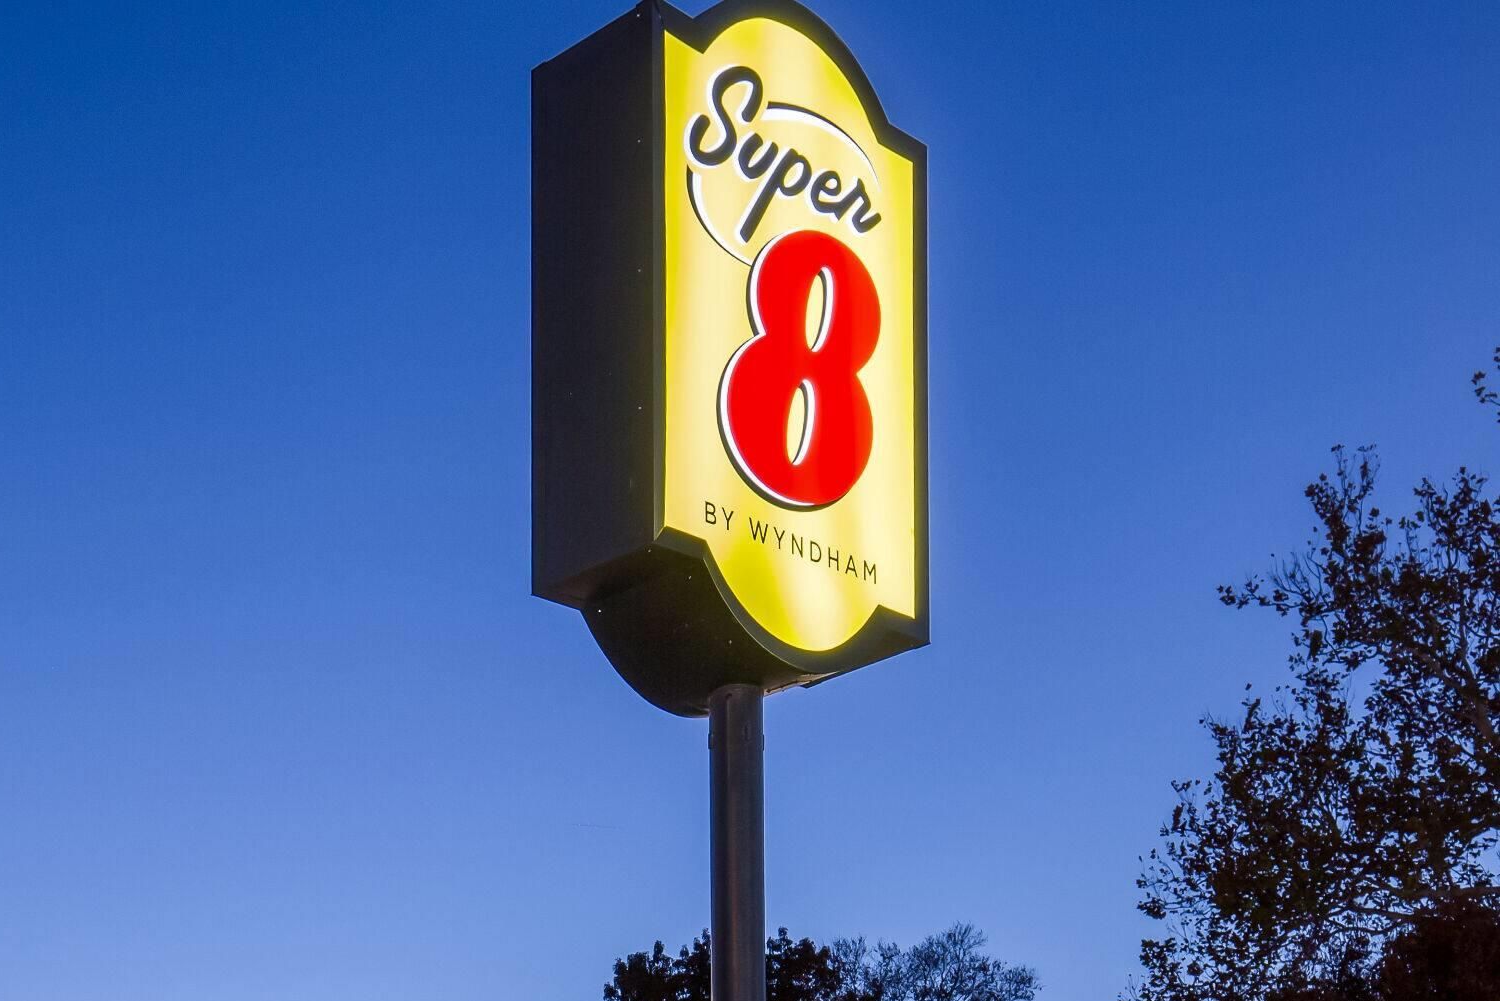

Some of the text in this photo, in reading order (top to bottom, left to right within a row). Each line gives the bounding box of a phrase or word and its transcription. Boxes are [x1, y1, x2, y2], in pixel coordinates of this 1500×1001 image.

[687, 65, 882, 244] Super
[716, 229, 881, 513] 8
[704, 501, 877, 585] BY WYNDHAM
